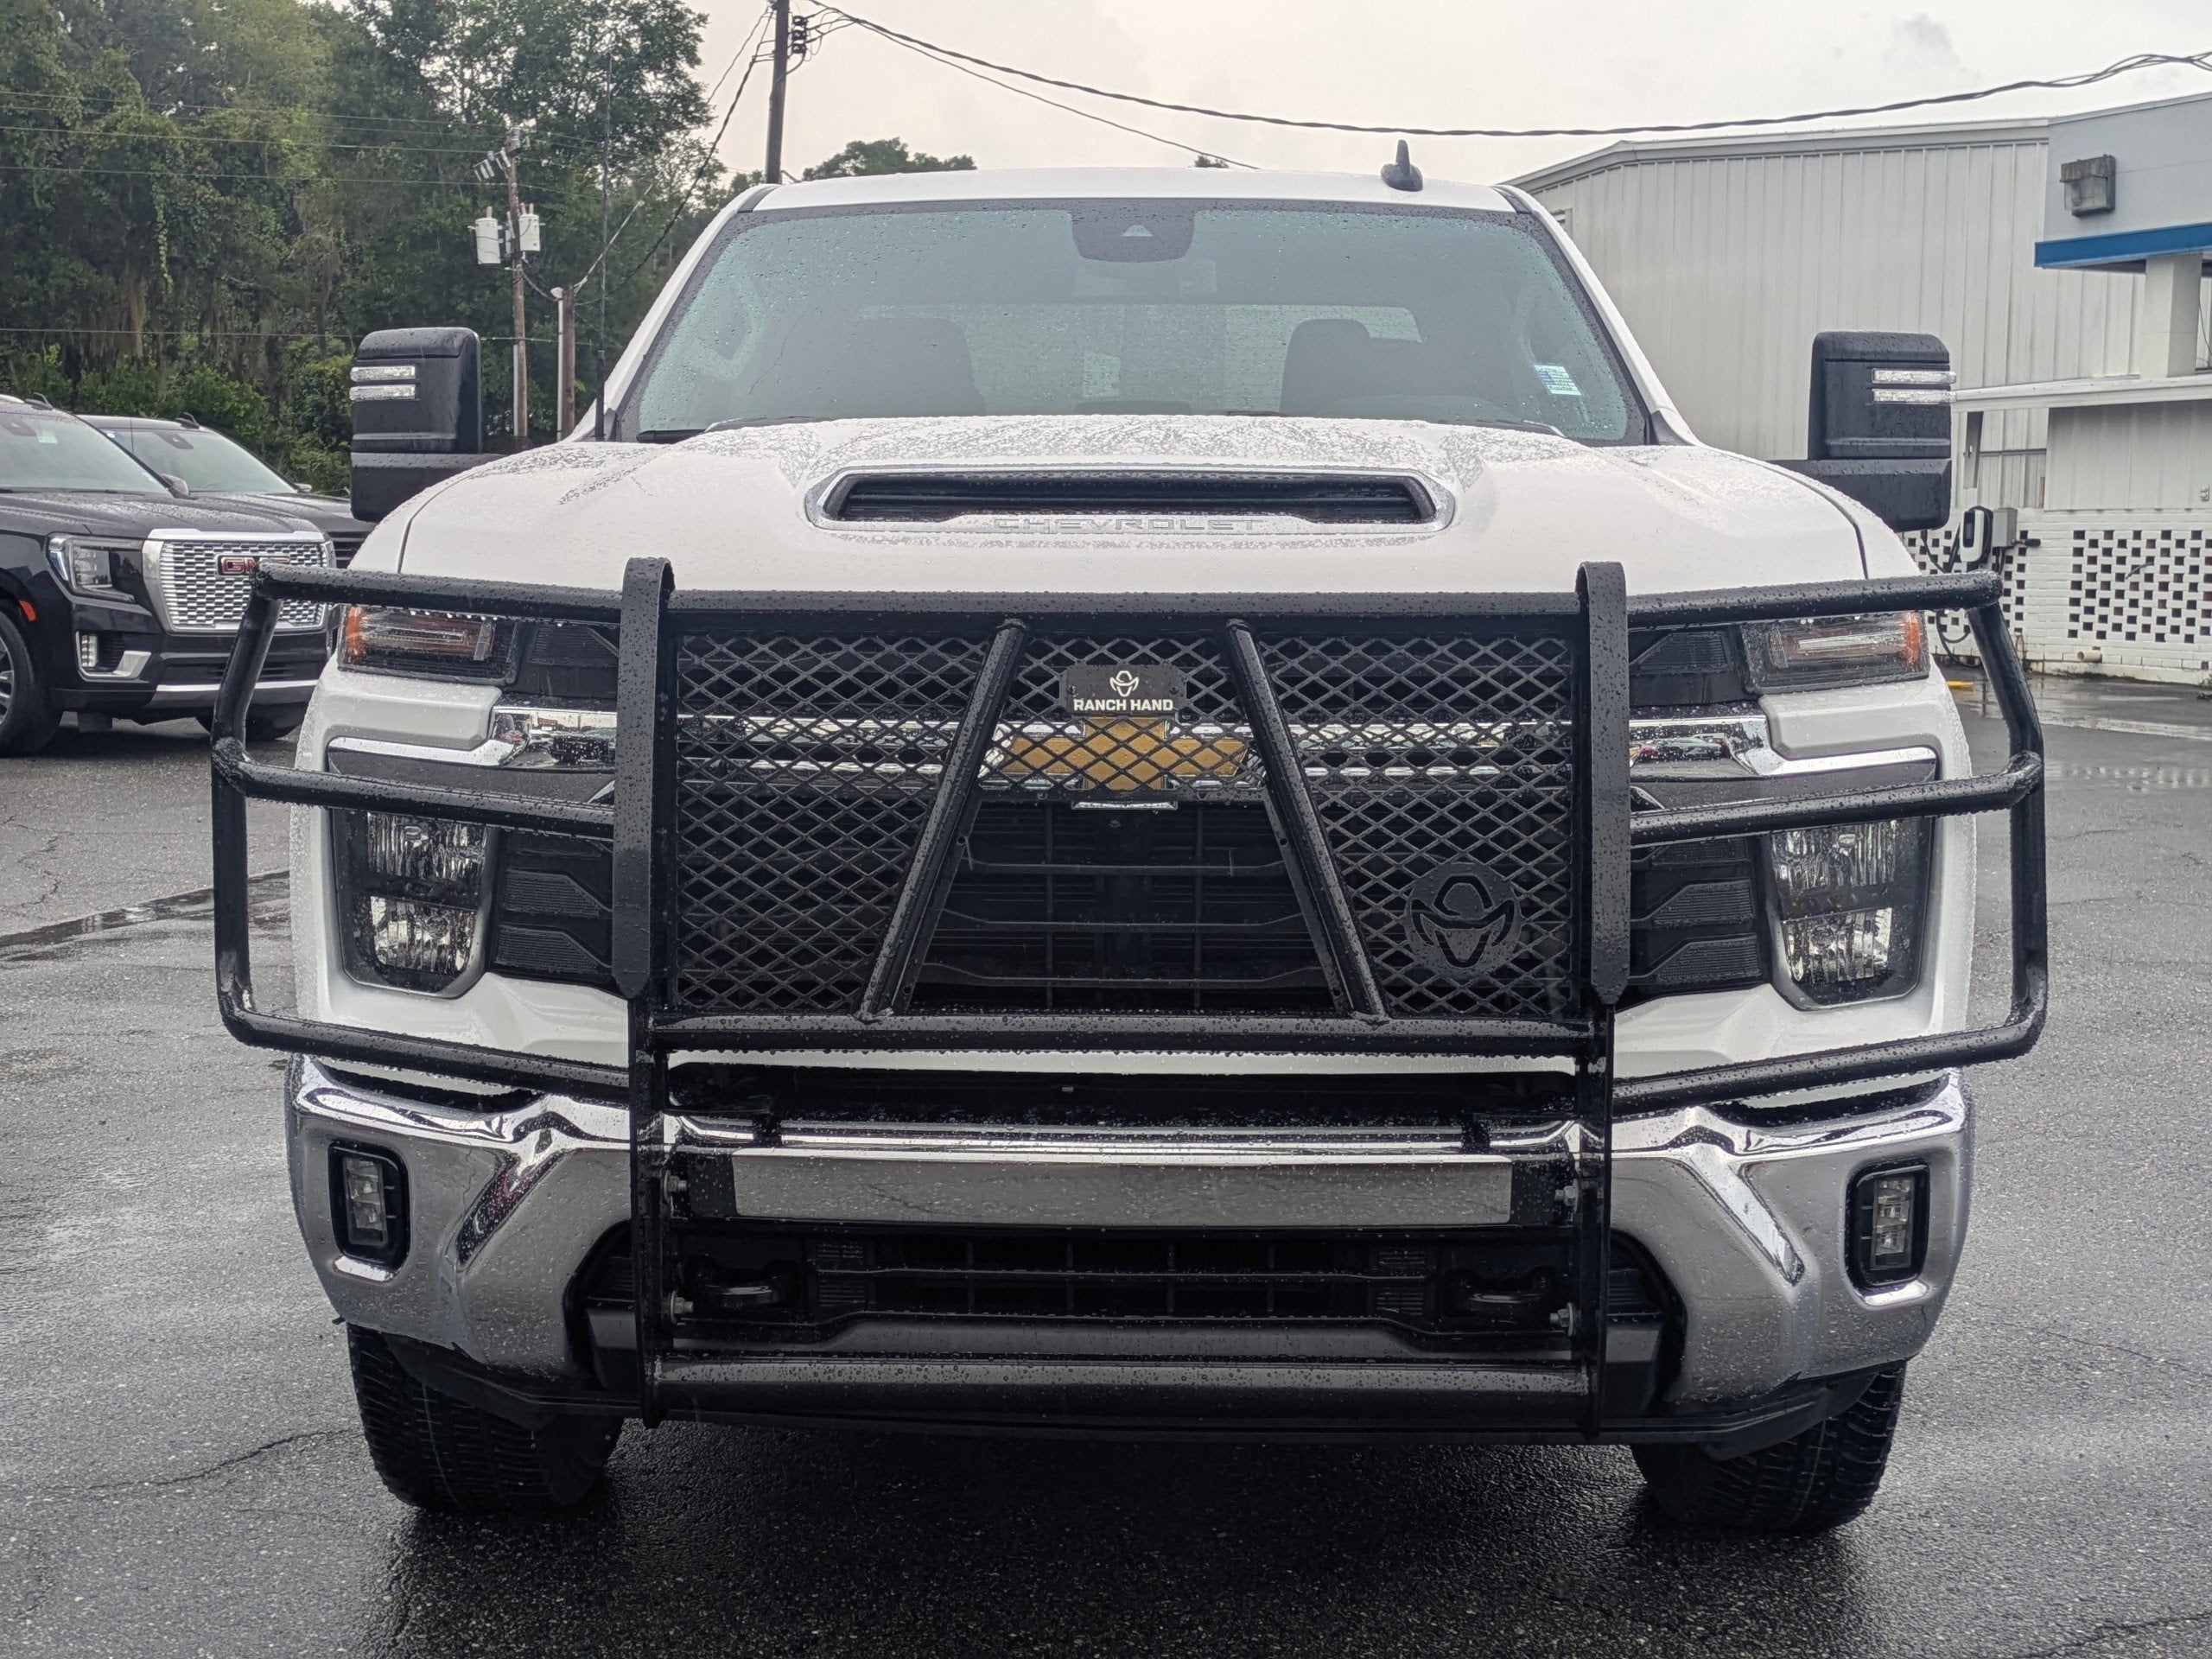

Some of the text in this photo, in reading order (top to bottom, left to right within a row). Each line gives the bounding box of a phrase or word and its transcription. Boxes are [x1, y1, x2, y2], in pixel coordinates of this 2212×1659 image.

[993, 518, 1264, 531] CHEVROLET
[1073, 699, 1173, 711] RANCH HAND
